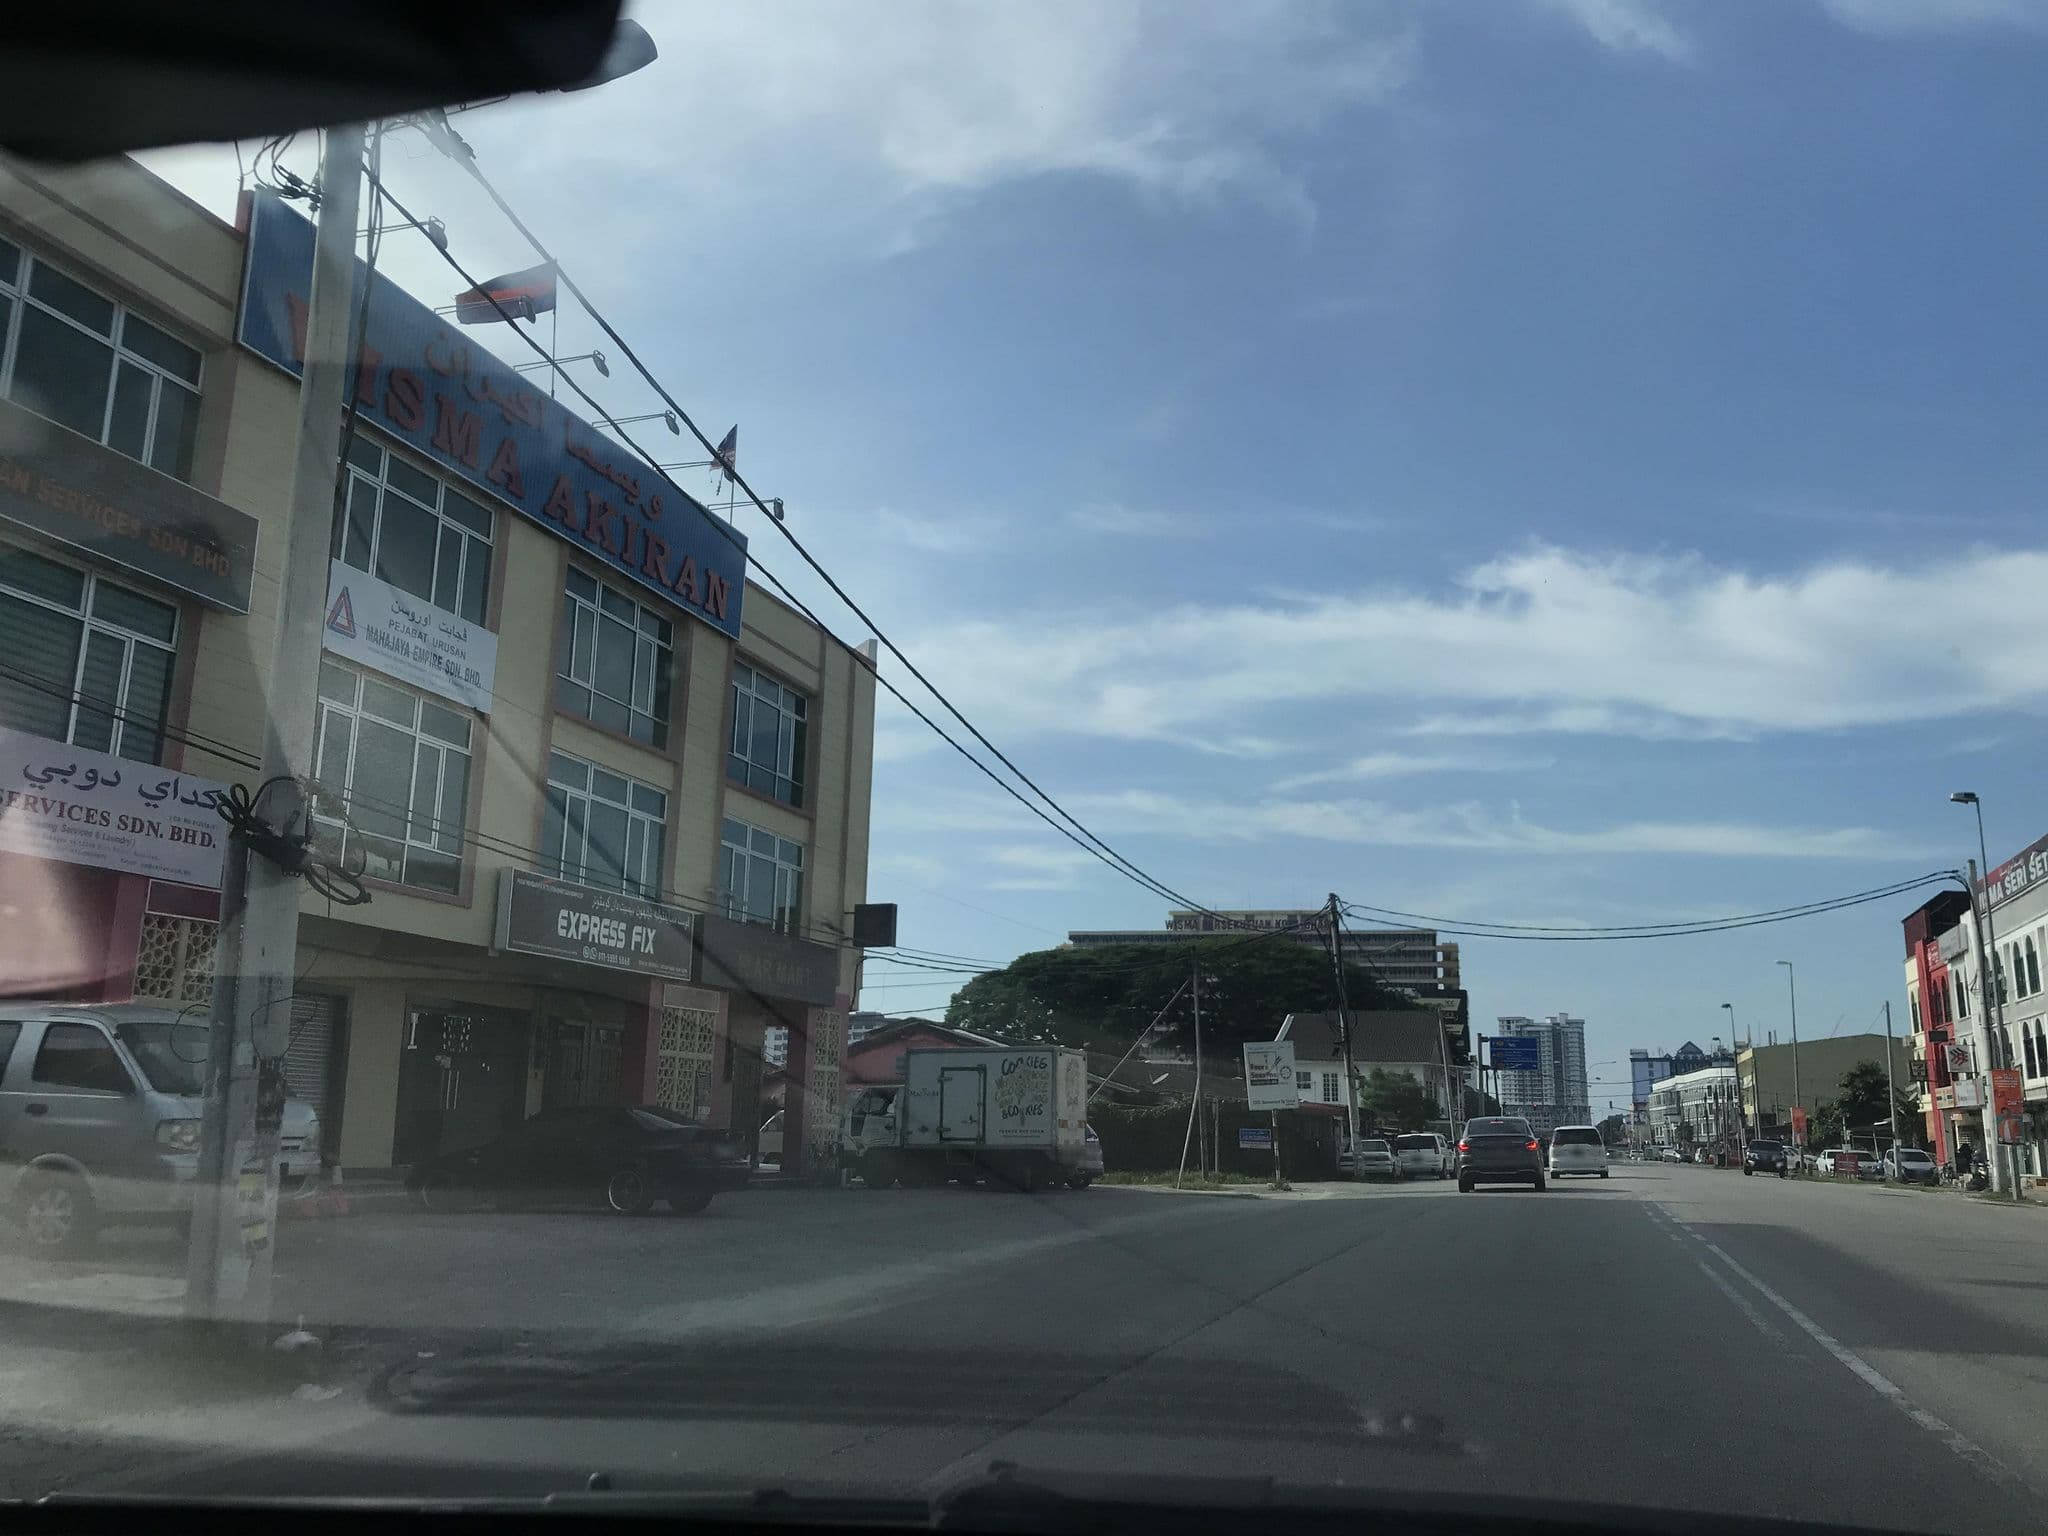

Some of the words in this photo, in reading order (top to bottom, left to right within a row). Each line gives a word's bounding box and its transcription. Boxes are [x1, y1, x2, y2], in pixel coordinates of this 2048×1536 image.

[191, 545, 231, 577] BHD
[543, 474, 732, 620] AKIRAN
[366, 624, 410, 657] MAHAJAYA
[389, 619, 428, 643] PEJABAT
[433, 639, 467, 660] URUSAN
[0, 788, 112, 828] ERVICES
[118, 814, 163, 839] SDN.
[168, 825, 217, 849] BHD.
[2005, 864, 2028, 896] SERI
[558, 908, 627, 949] EXPRESS
[631, 925, 656, 955] FIX
